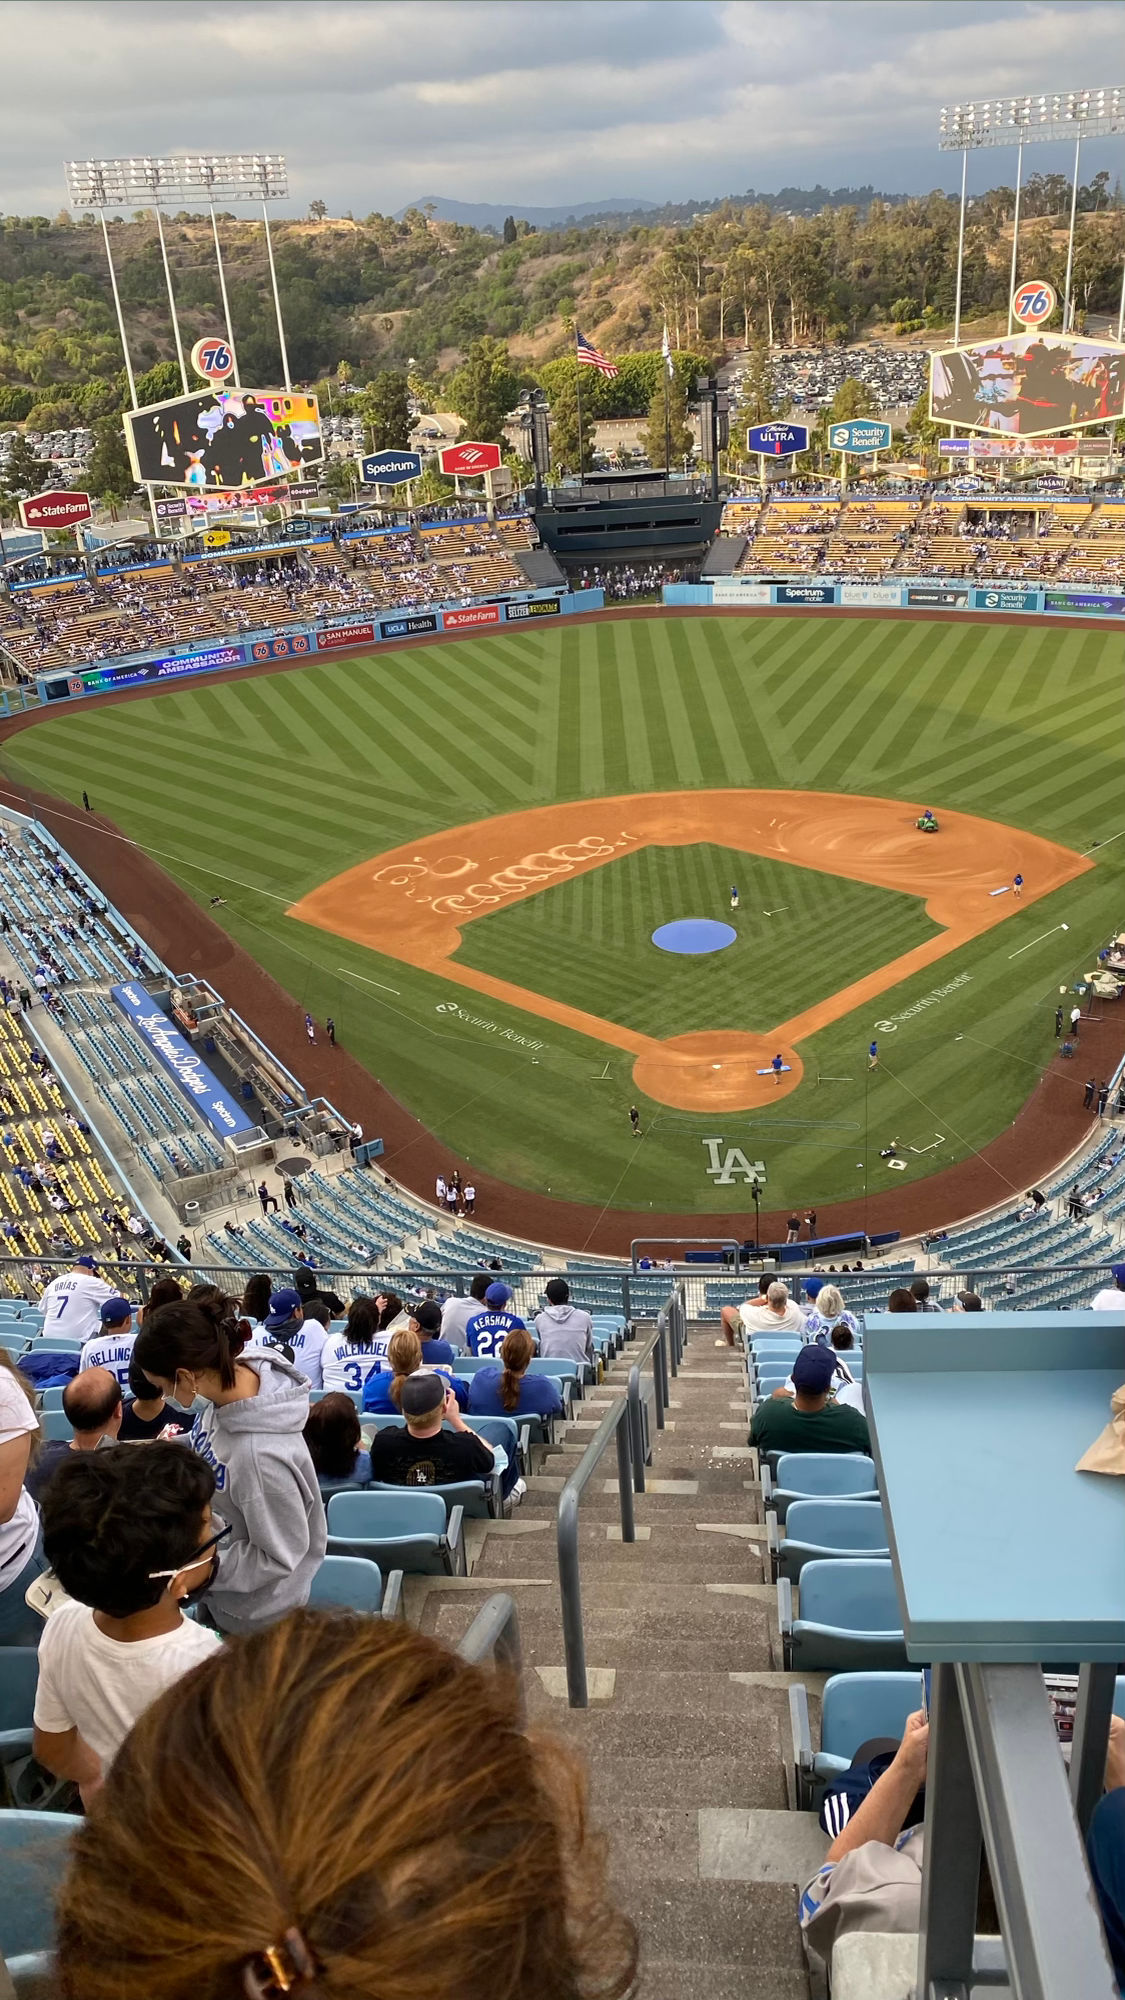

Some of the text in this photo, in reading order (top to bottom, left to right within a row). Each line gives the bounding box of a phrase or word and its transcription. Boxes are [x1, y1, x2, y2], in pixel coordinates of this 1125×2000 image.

[1018, 289, 1049, 317] 76
[201, 344, 231, 372] 76
[760, 432, 795, 442] ULTRA
[852, 428, 886, 438] Security
[852, 437, 881, 446] Benefit
[366, 461, 416, 476] Spectrum
[200, 539, 314, 559] COMMUNITY AMBASSADOR
[785, 588, 825, 597] Spectrum
[844, 591, 861, 599] blue
[873, 591, 889, 599] blue
[1000, 593, 1028, 602] Security
[1000, 601, 1024, 609] Benefit
[326, 627, 371, 640] SAN MANUEL
[387, 620, 433, 633] UCLA Health
[256, 646, 267, 655] 76
[275, 642, 286, 651] 76
[295, 640, 305, 649] 76
[158, 654, 241, 676] AMBASSADOR
[162, 650, 234, 668] COMMUNITY
[111, 672, 138, 681] AMERICA
[121, 985, 142, 1006] Spectrum
[890, 972, 973, 1022] Security Benefit
[453, 1009, 544, 1050] Security Benefit
[136, 1013, 212, 1094] Los Angeles Dodgers
[211, 1101, 237, 1128] Spectrum
[702, 1138, 767, 1184] LA
[57, 1296, 69, 1318] 7
[473, 1315, 513, 1331] KERSHAW
[90, 1347, 131, 1367] BELLING
[334, 1341, 389, 1360] VALENZUEL
[416, 1469, 427, 1482] LA
